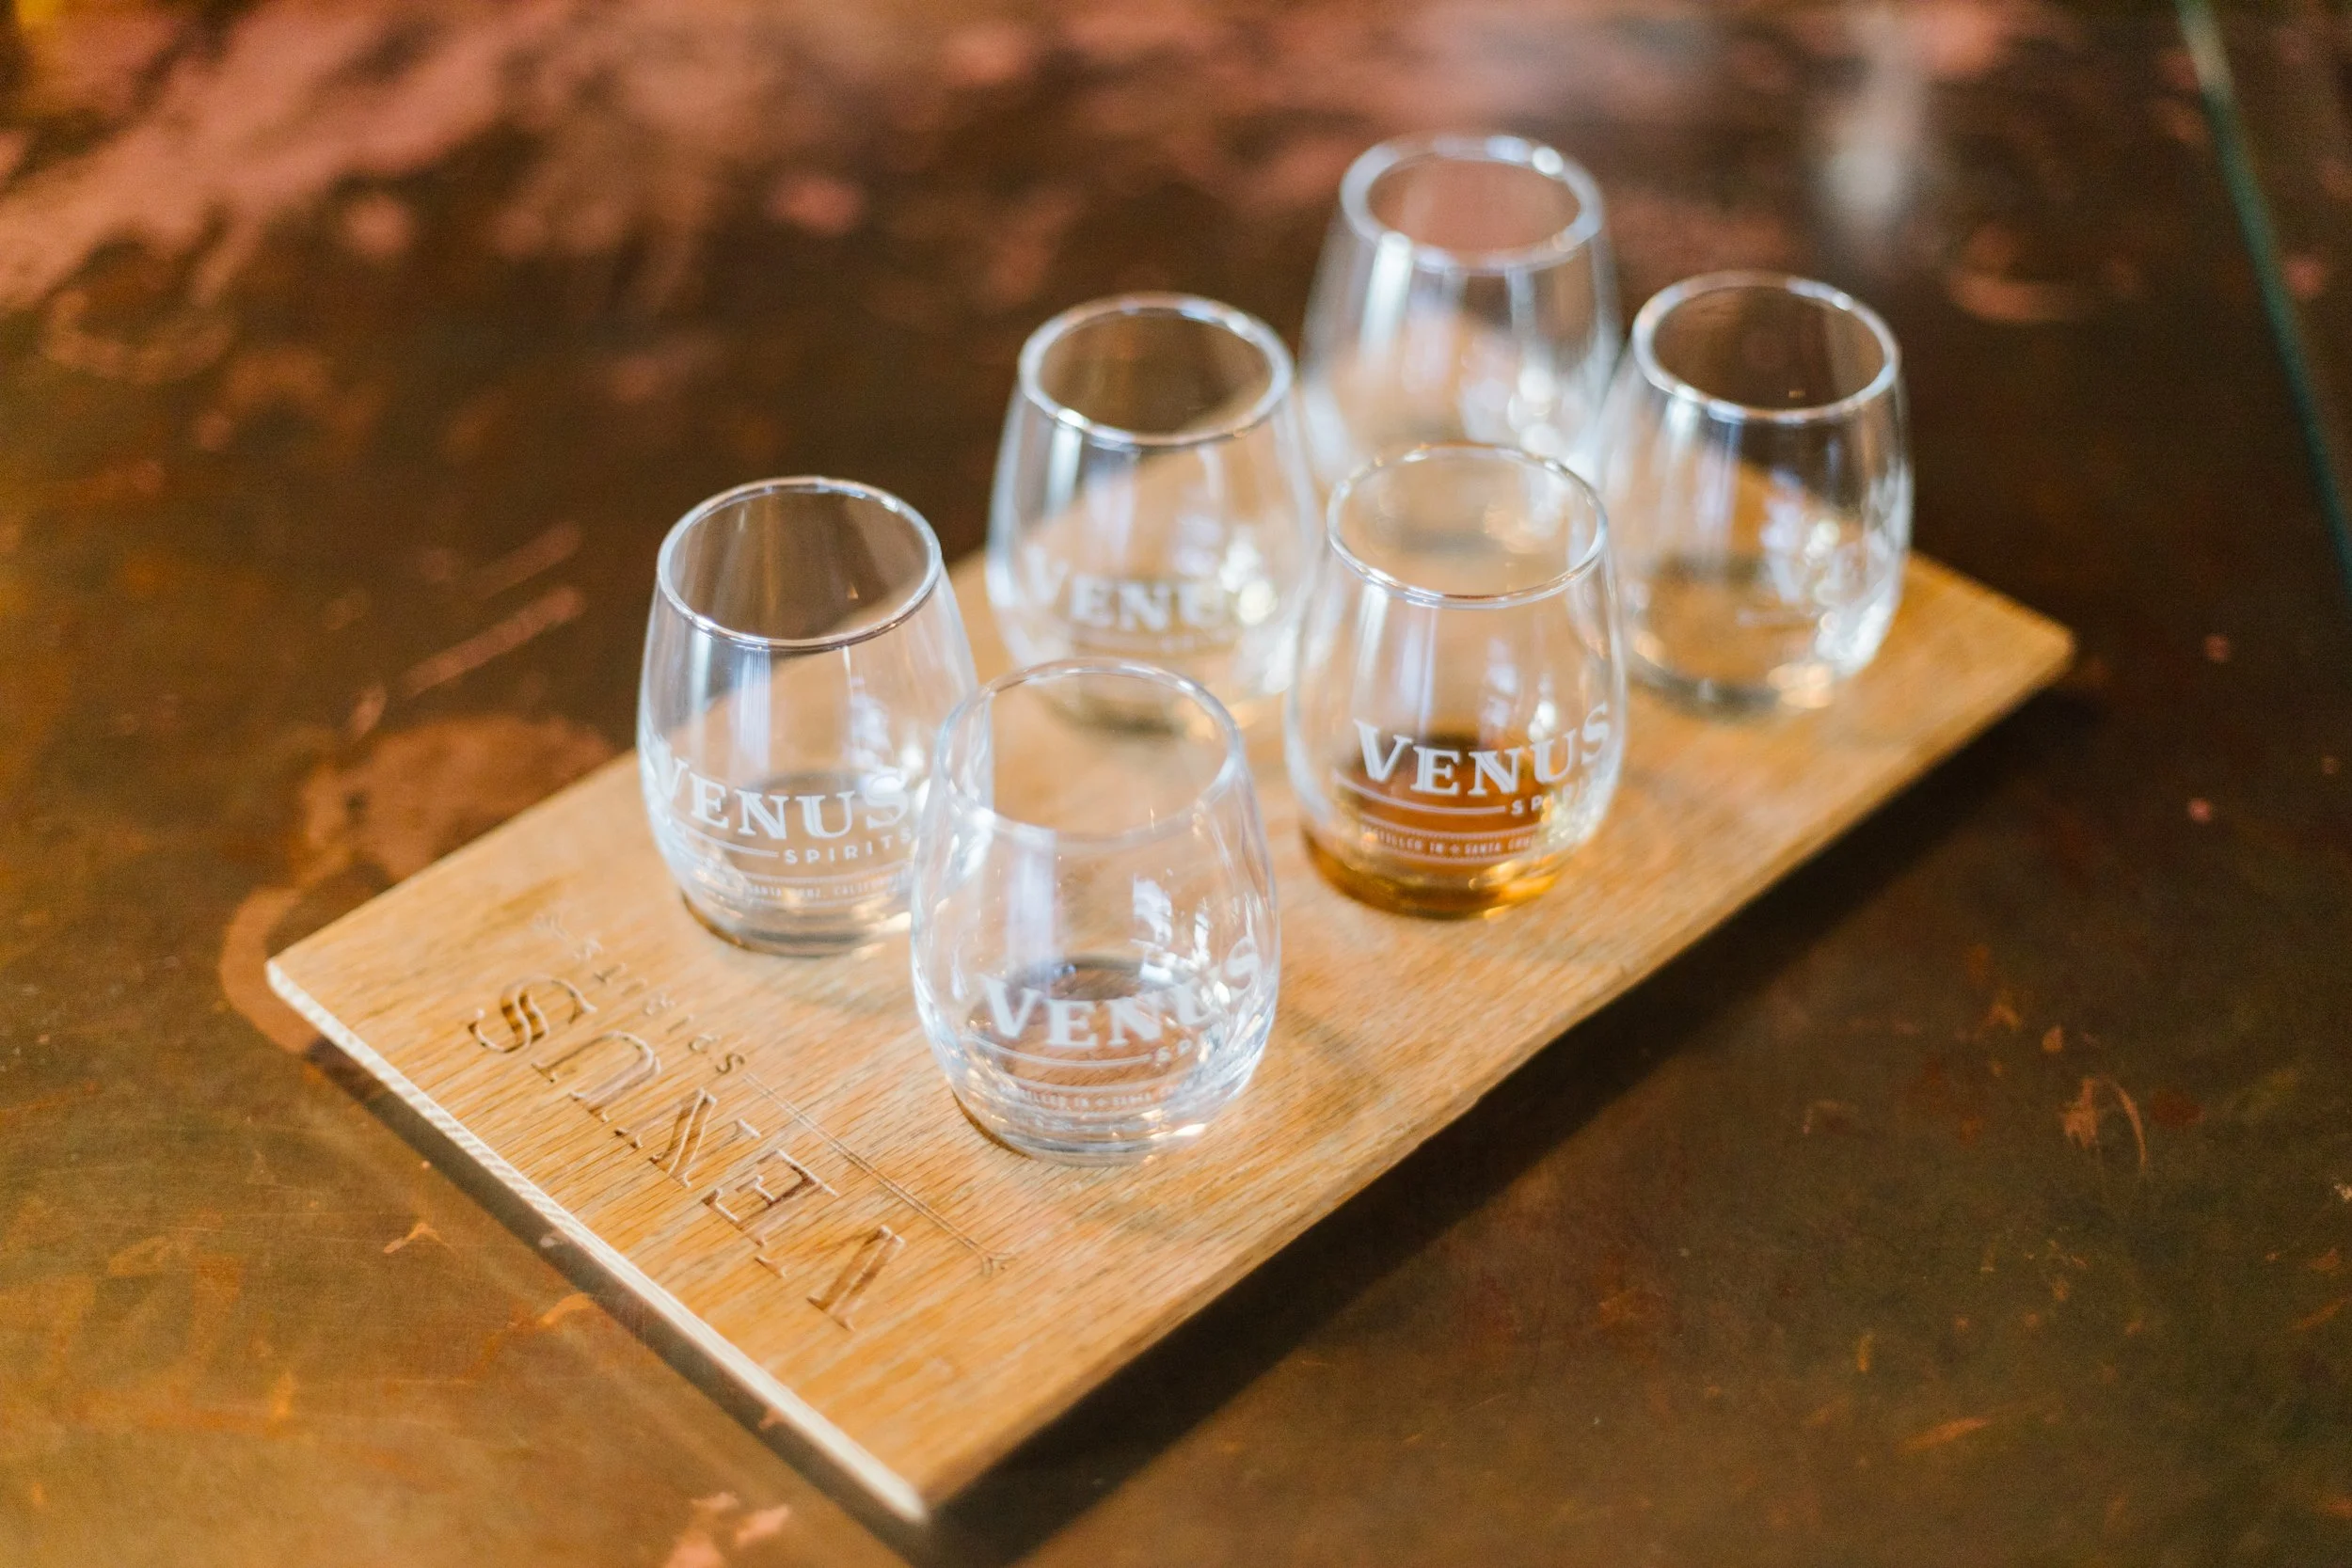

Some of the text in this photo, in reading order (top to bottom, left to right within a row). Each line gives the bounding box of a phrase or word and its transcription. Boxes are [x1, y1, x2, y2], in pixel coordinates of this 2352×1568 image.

[1024, 540, 1227, 632] VENU
[1353, 701, 1612, 797] VENUS
[658, 757, 910, 840] VENUS
[783, 826, 913, 864] SPIRITS
[977, 937, 1261, 1049] VENUS
[467, 974, 906, 1332] VENUS
